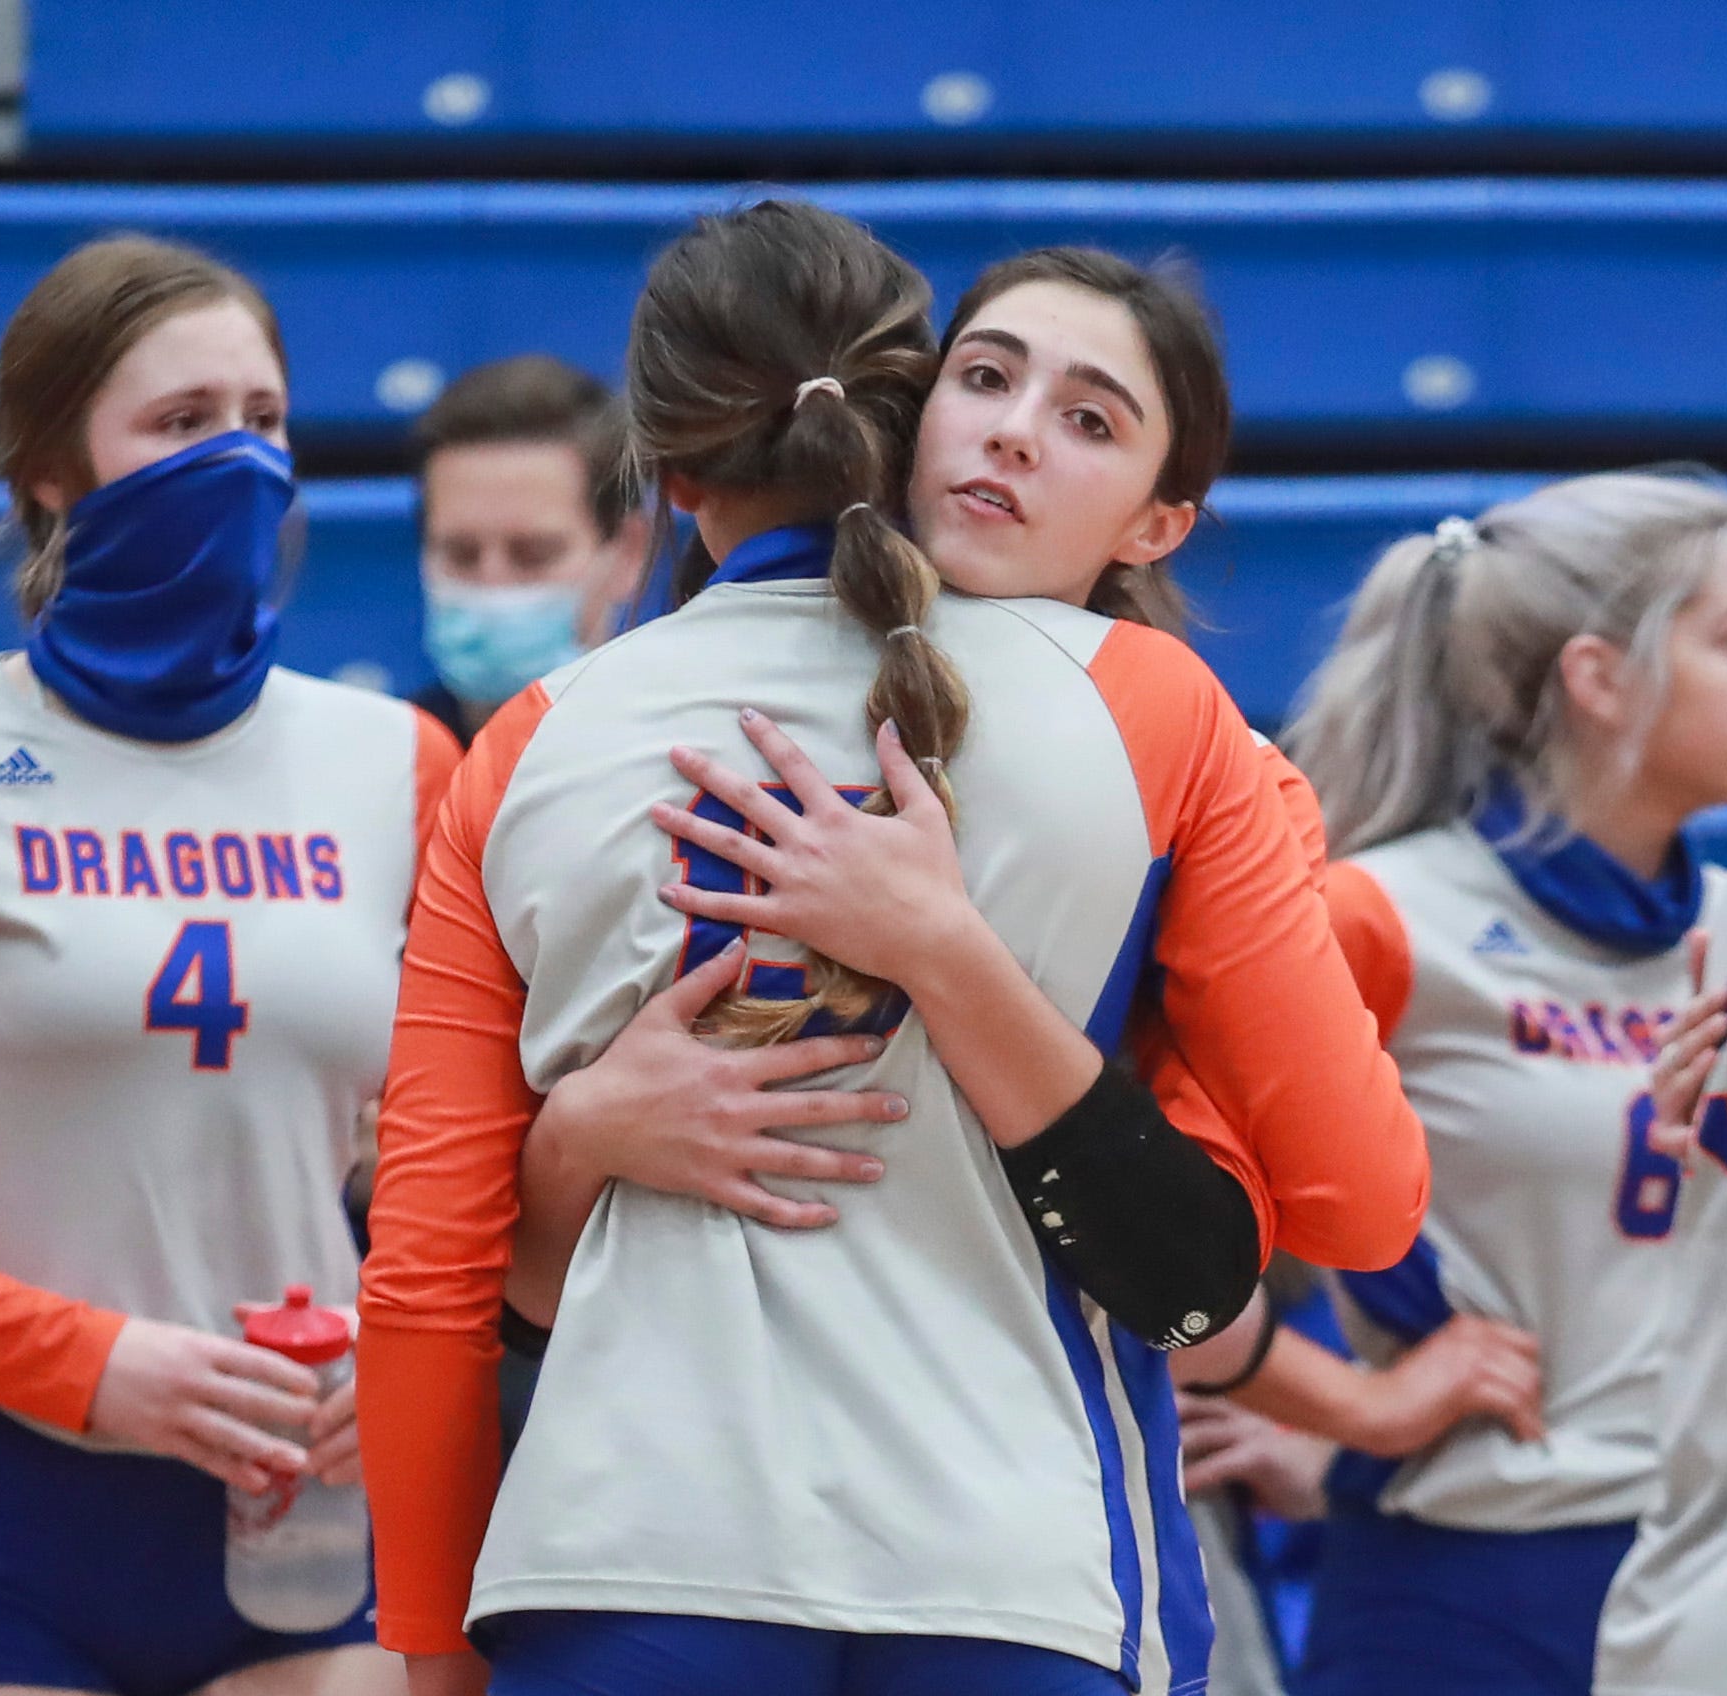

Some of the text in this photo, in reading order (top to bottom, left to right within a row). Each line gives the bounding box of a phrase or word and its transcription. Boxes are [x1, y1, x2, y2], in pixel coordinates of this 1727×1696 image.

[15, 824, 345, 903] DRAGONS
[143, 917, 249, 1072] 4
[1611, 1091, 1681, 1242] 6
